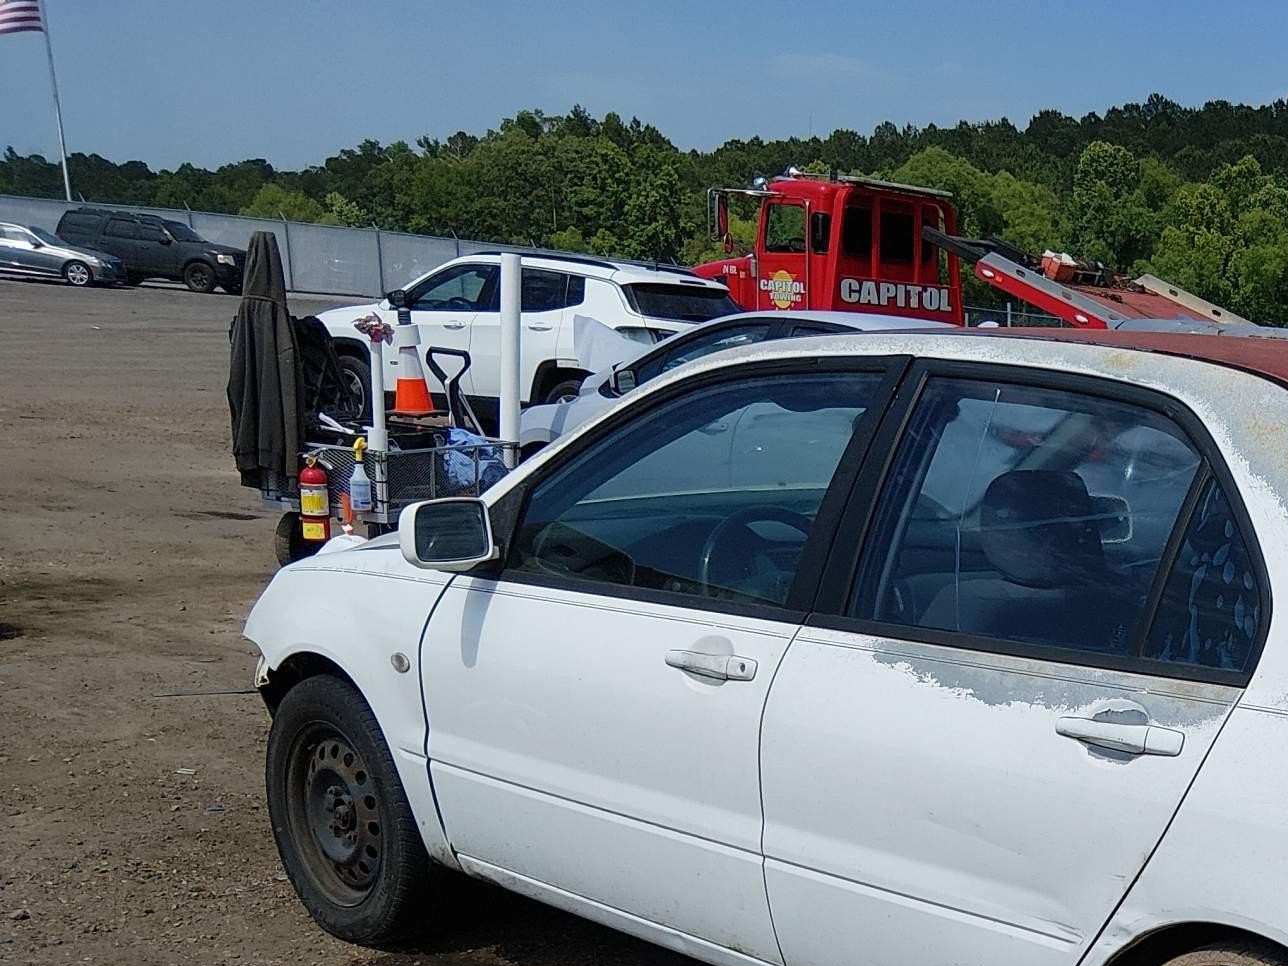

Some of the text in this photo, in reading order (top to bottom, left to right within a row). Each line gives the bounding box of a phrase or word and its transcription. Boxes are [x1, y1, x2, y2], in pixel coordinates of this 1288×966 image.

[760, 279, 806, 294] CAPITOL
[769, 292, 802, 302] TOWING
[840, 278, 953, 312] CAPITOL
